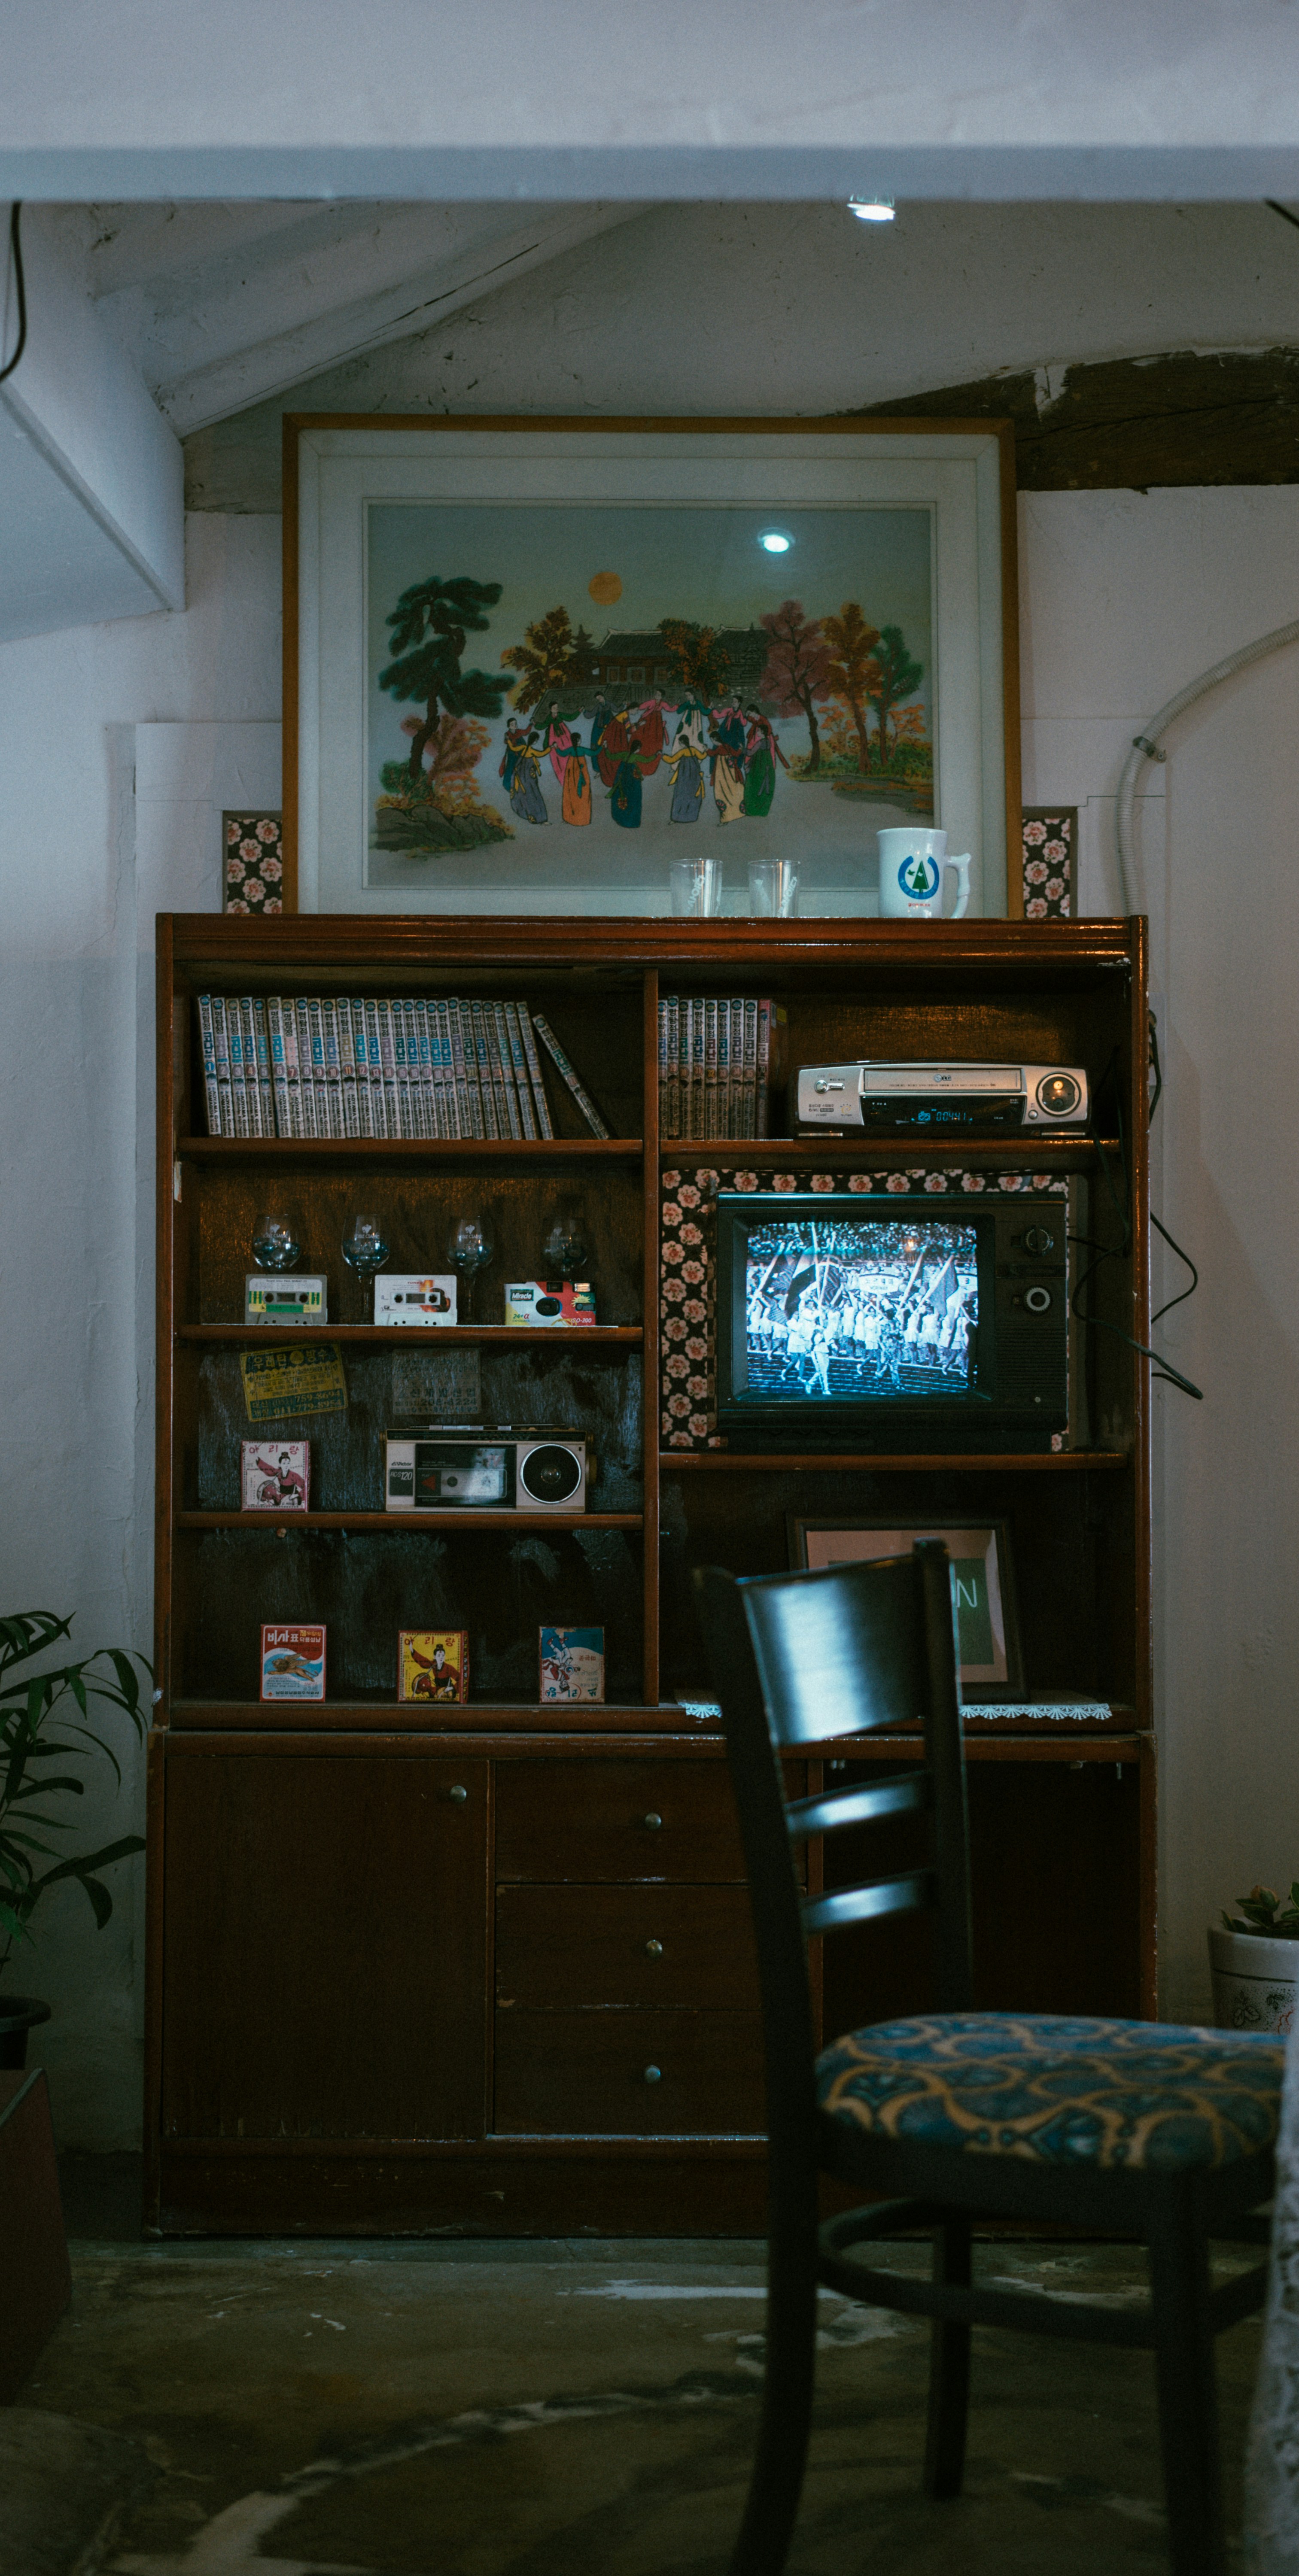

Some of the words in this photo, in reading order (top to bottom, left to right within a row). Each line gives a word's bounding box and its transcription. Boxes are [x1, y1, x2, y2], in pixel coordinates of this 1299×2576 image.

[254, 1353, 287, 1369] 우레탄
[306, 1348, 328, 1363] 방수
[295, 1390, 341, 1403] 759-8694
[249, 1444, 299, 1455] 아리랑
[267, 1630, 299, 1645] 비사표
[405, 1636, 456, 1647] 아리랑
